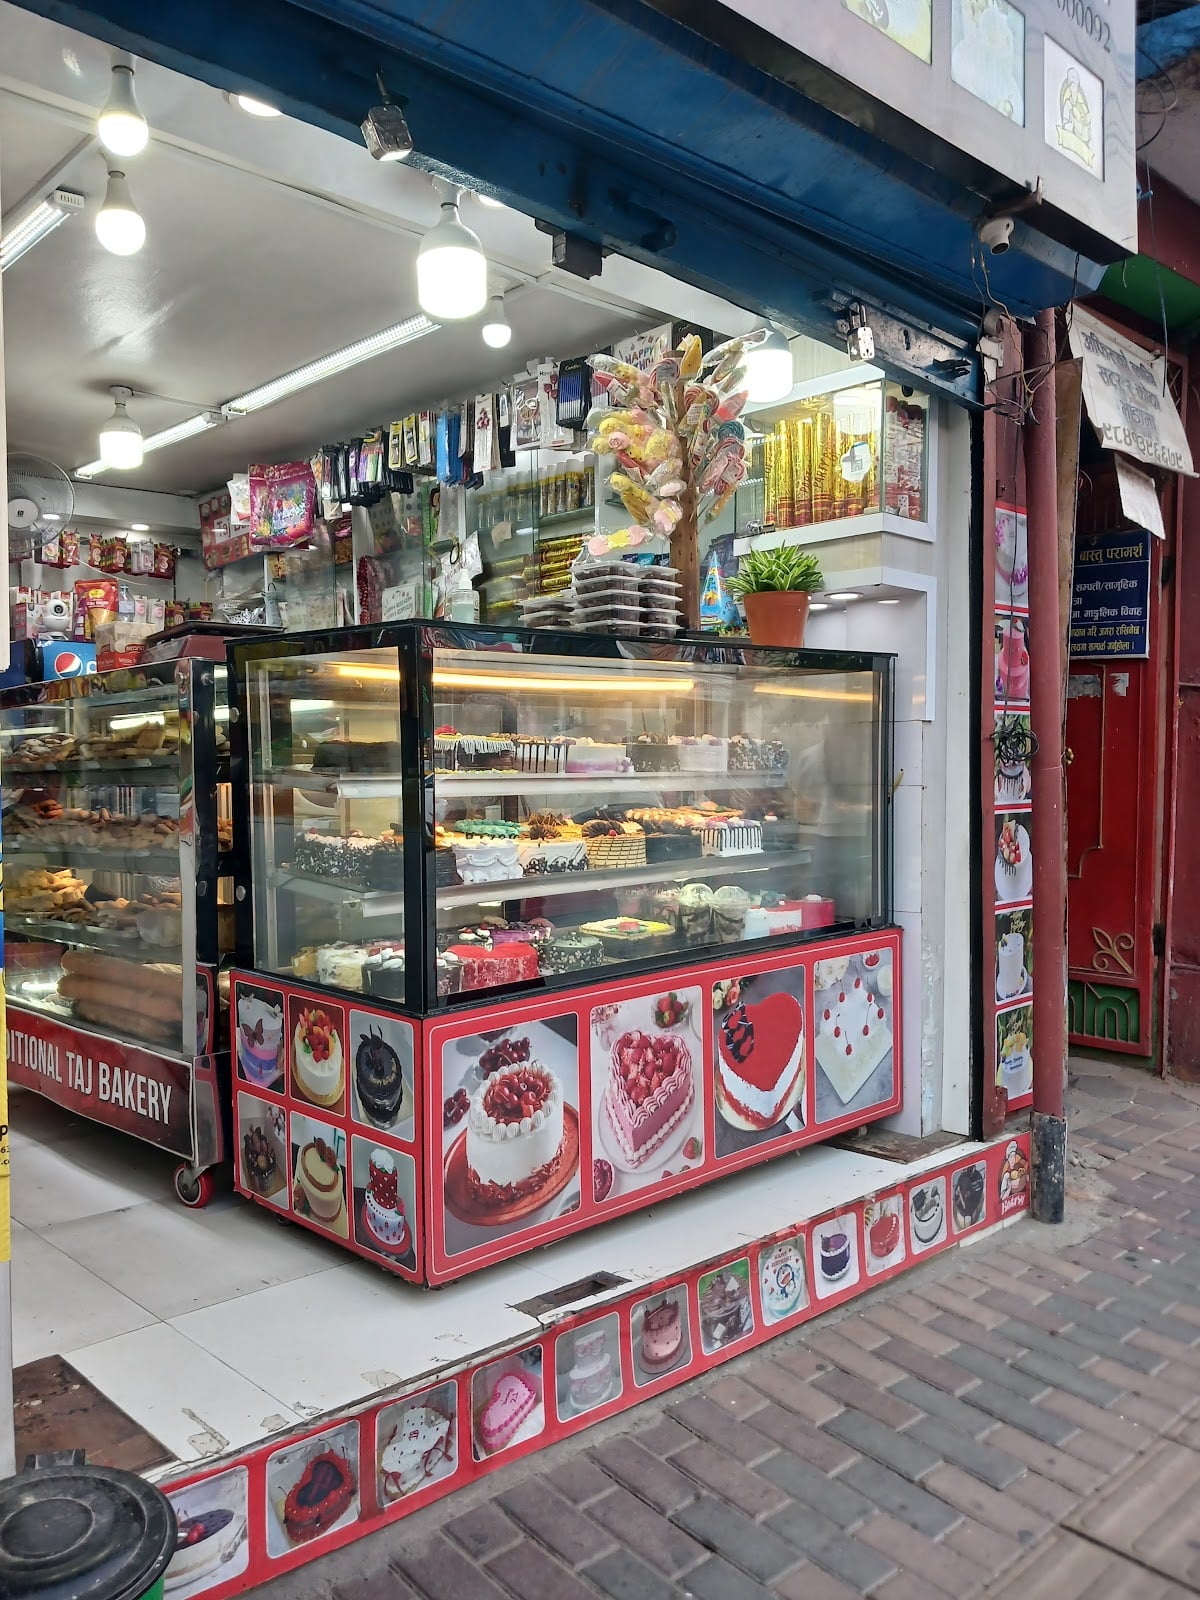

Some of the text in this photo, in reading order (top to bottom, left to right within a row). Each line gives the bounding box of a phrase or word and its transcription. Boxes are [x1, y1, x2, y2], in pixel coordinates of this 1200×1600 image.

[1107, 543, 1143, 559] परामर्श
[1120, 605, 1143, 617] विवाह
[66, 1052, 93, 1095] TAJ
[98, 1062, 172, 1124] BAKERY
